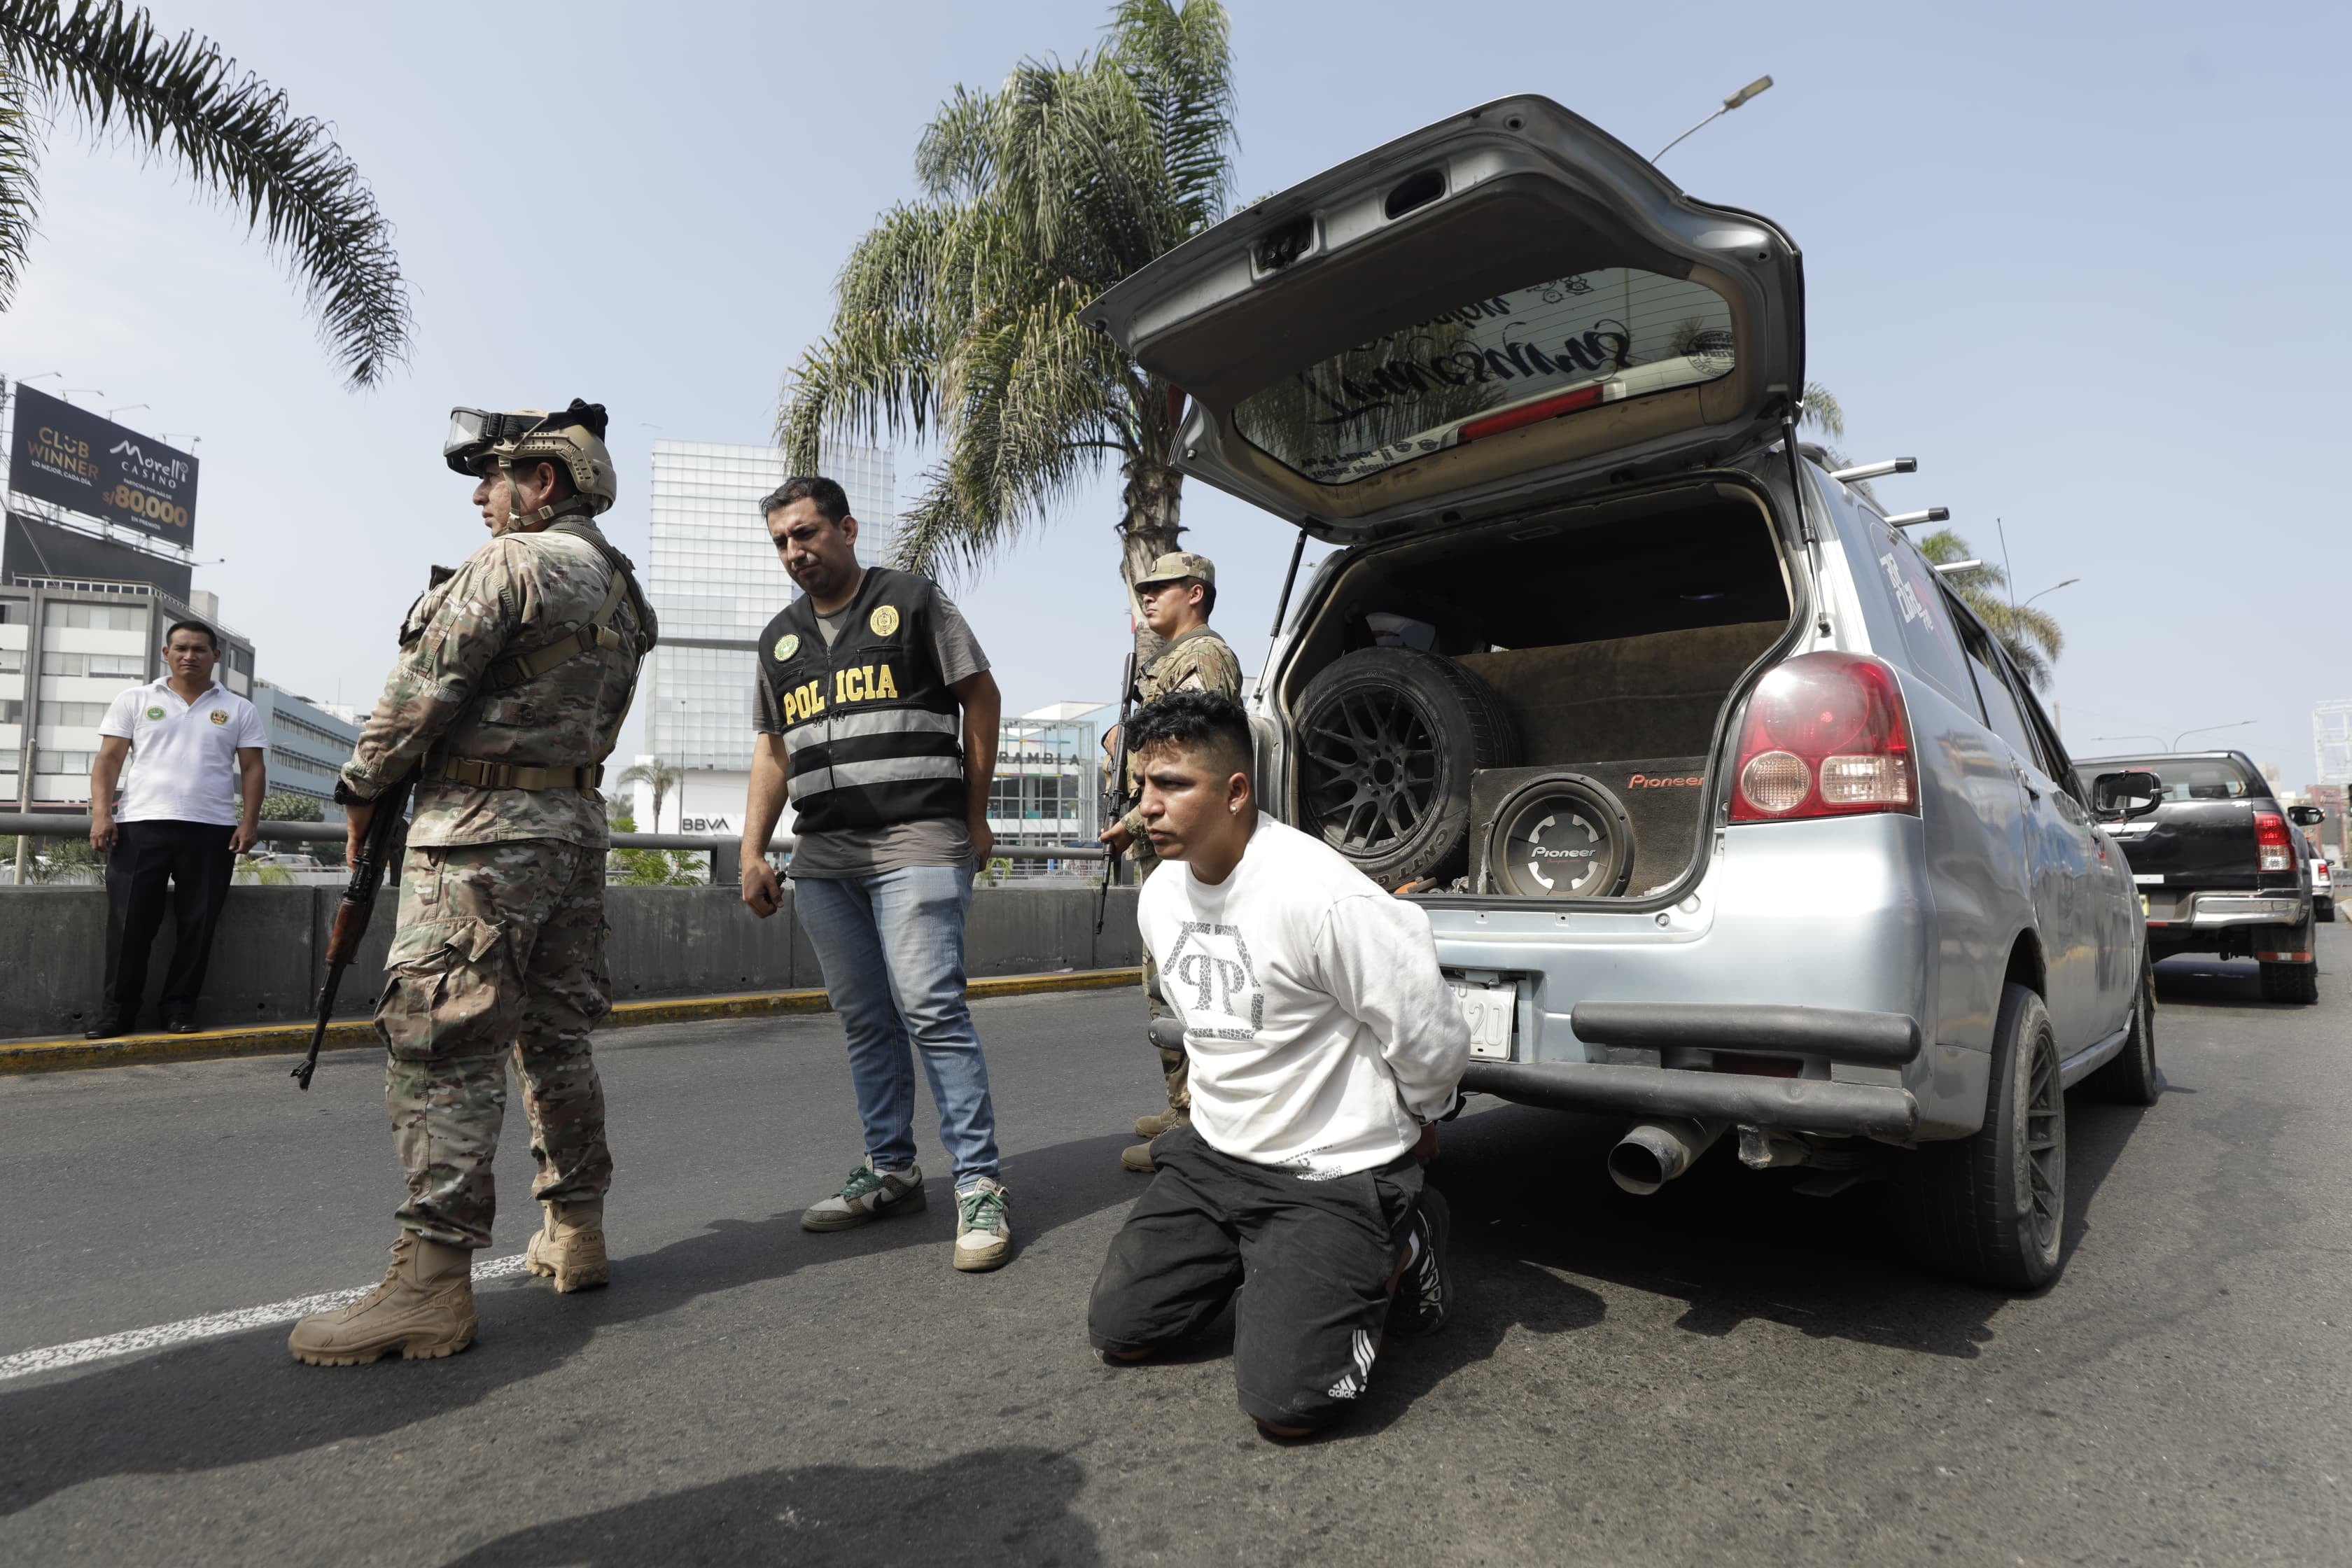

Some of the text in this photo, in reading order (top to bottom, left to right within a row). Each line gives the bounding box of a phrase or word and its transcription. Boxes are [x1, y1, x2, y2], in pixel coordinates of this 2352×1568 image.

[38, 426, 90, 458] CLUB
[27, 439, 99, 481] WINNER
[109, 440, 189, 482] Morelli
[63, 471, 80, 482] CADA
[121, 461, 177, 489] CASINO
[139, 518, 161, 531] PREMIOS
[997, 751, 1080, 766] RAMBLA
[1628, 774, 1705, 790] Pioneer
[682, 818, 729, 831] BBVA
[1531, 846, 1597, 858] Pioneer
